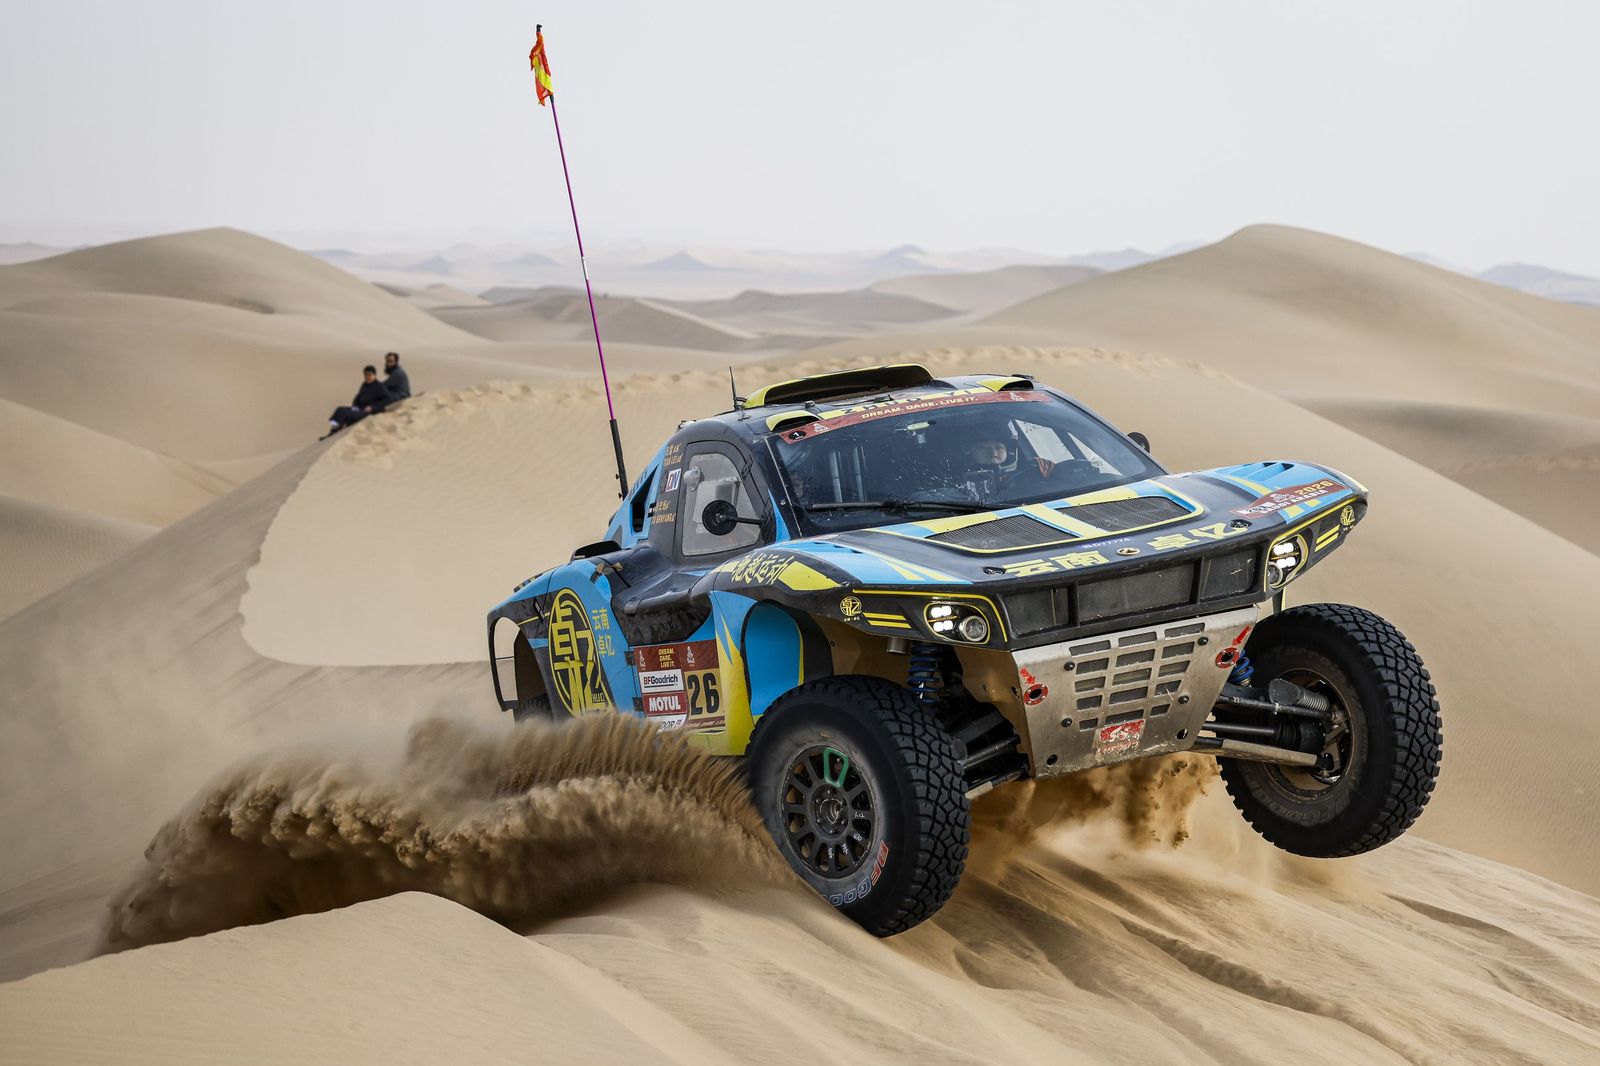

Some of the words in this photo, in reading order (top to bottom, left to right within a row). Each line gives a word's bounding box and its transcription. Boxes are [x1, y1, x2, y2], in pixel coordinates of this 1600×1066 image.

[861, 406, 905, 419] DREAM.
[906, 400, 938, 411] DARE.
[940, 397, 964, 407] LIVE
[965, 395, 979, 404] IT.
[1295, 480, 1334, 496] 2026
[1260, 500, 1291, 514] SAUDI
[1291, 488, 1329, 503] ARABIA
[1002, 550, 1110, 578] 云南
[1147, 522, 1252, 551] 卓亿
[658, 647, 675, 655] DREAM.
[643, 674, 679, 685] BFGoodrich
[649, 695, 682, 711] MOTUL
[687, 672, 720, 715] 26
